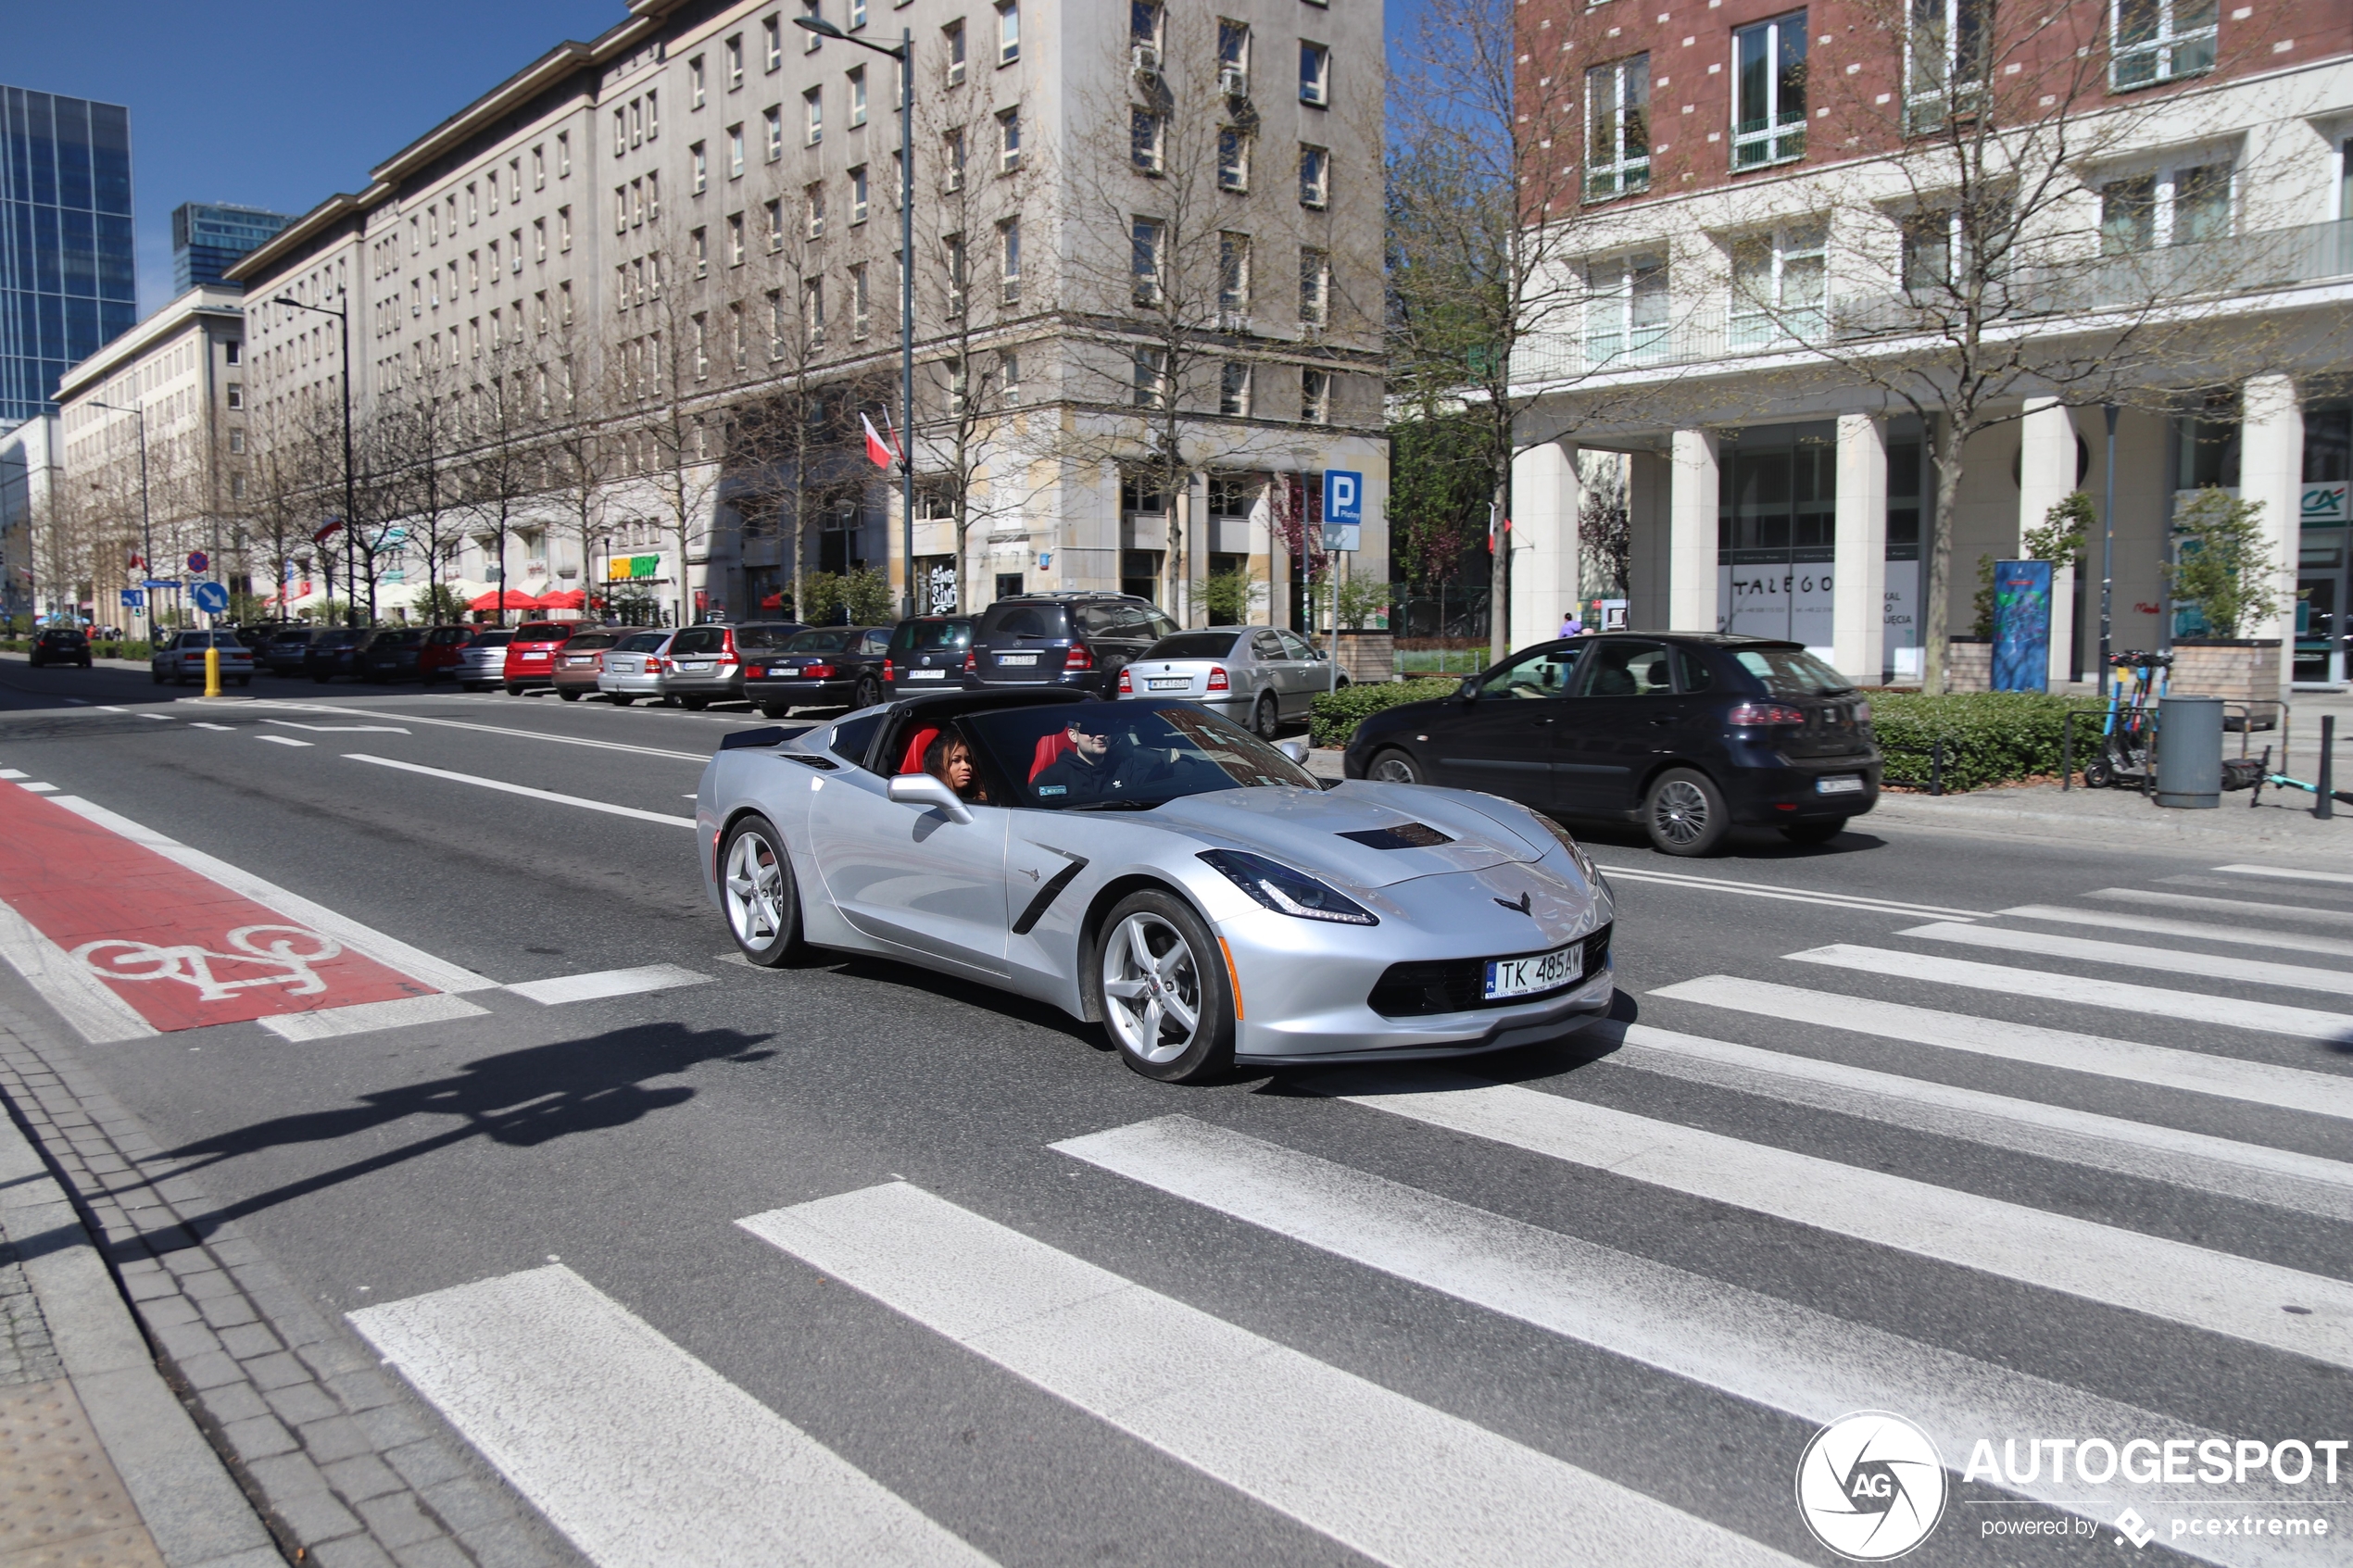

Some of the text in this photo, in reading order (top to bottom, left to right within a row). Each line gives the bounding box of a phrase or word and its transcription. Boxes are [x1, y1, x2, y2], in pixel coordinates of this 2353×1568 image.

[1332, 476, 1354, 517] P
[609, 554, 660, 579] SUBWAY
[1503, 960, 1529, 989] TK
[1536, 946, 1580, 982] 485AW
